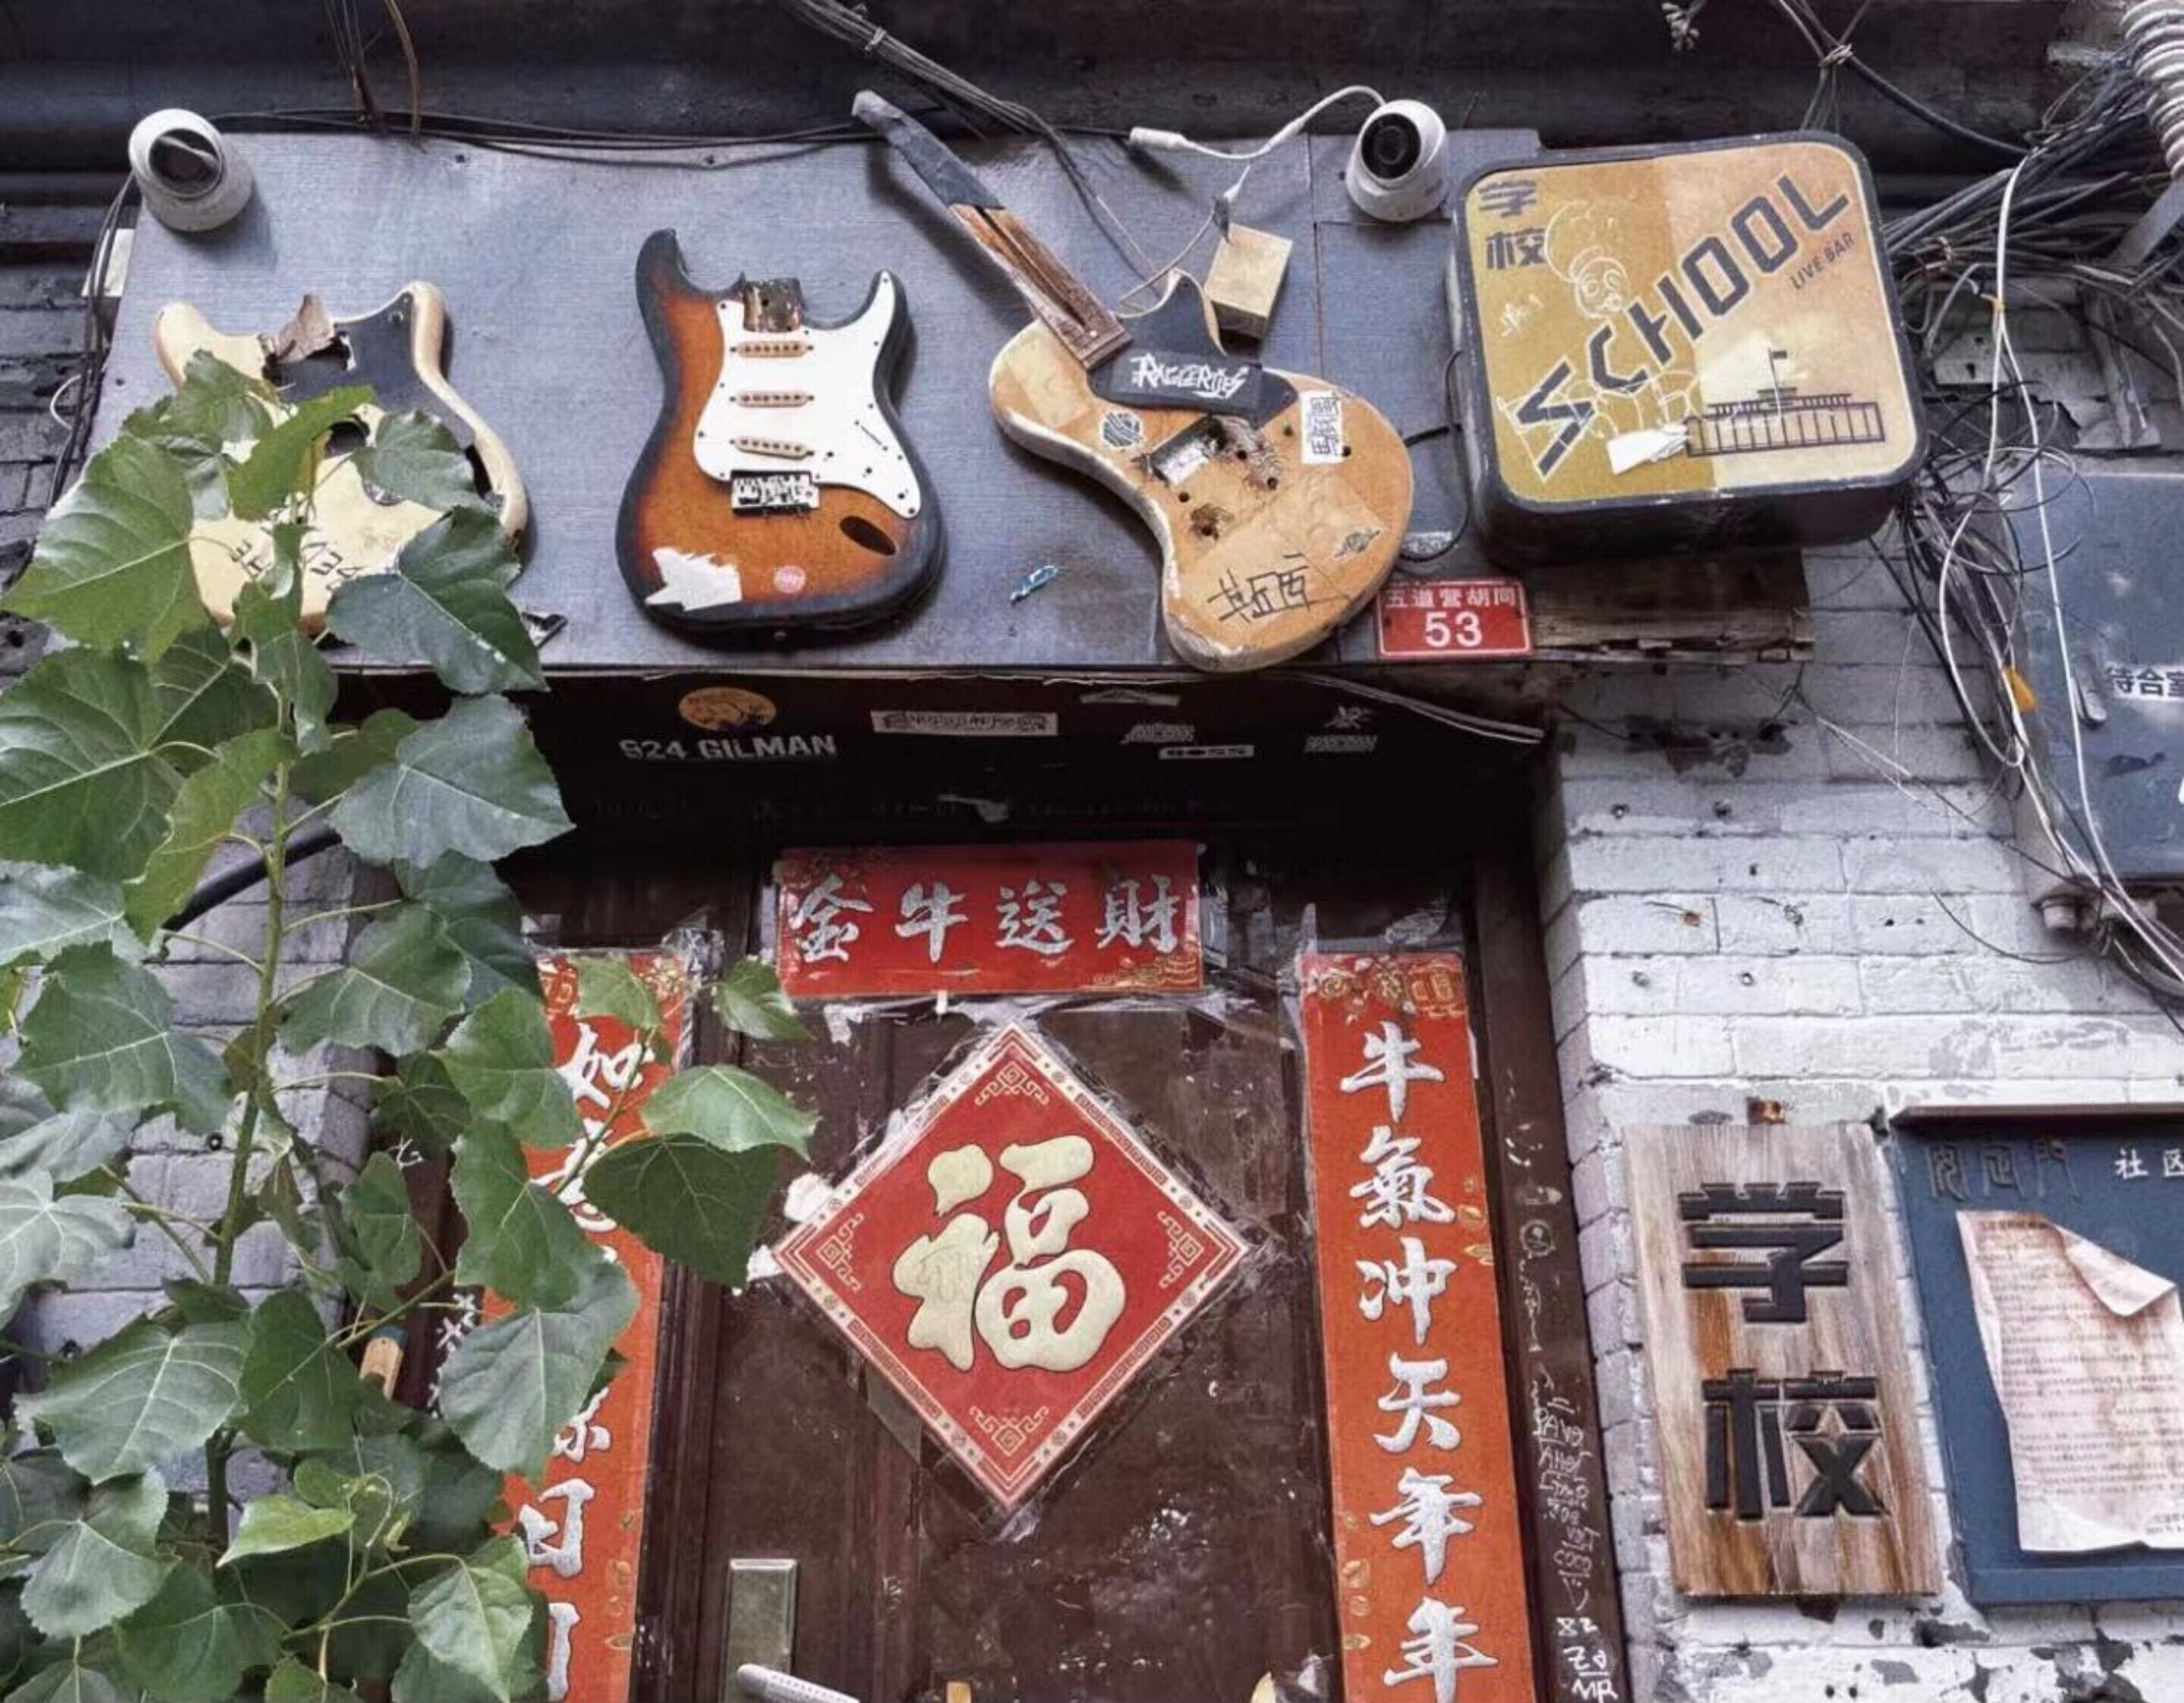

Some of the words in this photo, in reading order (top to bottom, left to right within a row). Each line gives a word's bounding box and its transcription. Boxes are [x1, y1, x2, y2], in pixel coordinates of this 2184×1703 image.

[1477, 179, 1549, 269] 学校
[1789, 256, 1824, 290] LIVE
[1824, 231, 1855, 263] BAR
[1514, 173, 1850, 476] SCHOOL
[1425, 610, 1483, 648] 53
[698, 733, 838, 760] GILMAN
[789, 873, 1181, 964] 金牛送財
[893, 1134, 1127, 1373] 福
[1678, 1181, 1888, 1520] 学校
